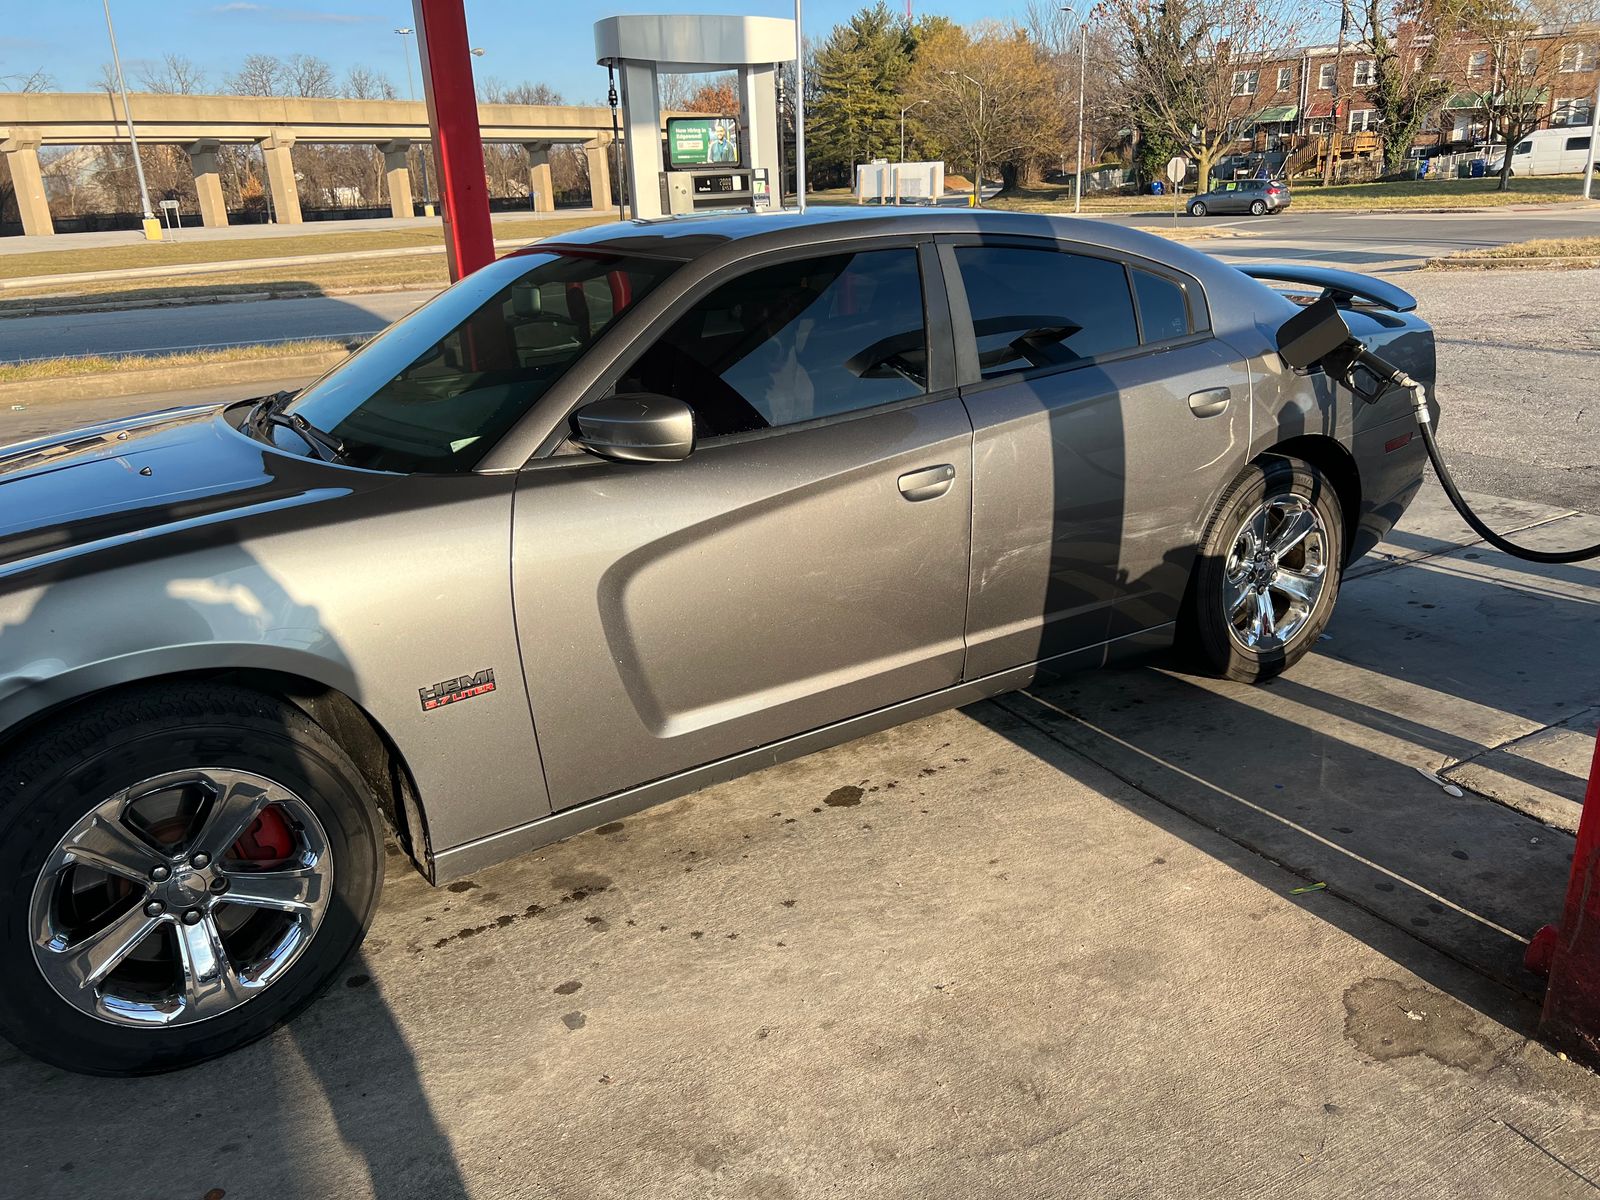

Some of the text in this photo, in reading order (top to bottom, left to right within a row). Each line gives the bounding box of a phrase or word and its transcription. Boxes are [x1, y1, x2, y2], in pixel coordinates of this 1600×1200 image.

[418, 668, 495, 700] HEMI
[425, 682, 495, 710] 5.7 LITER
